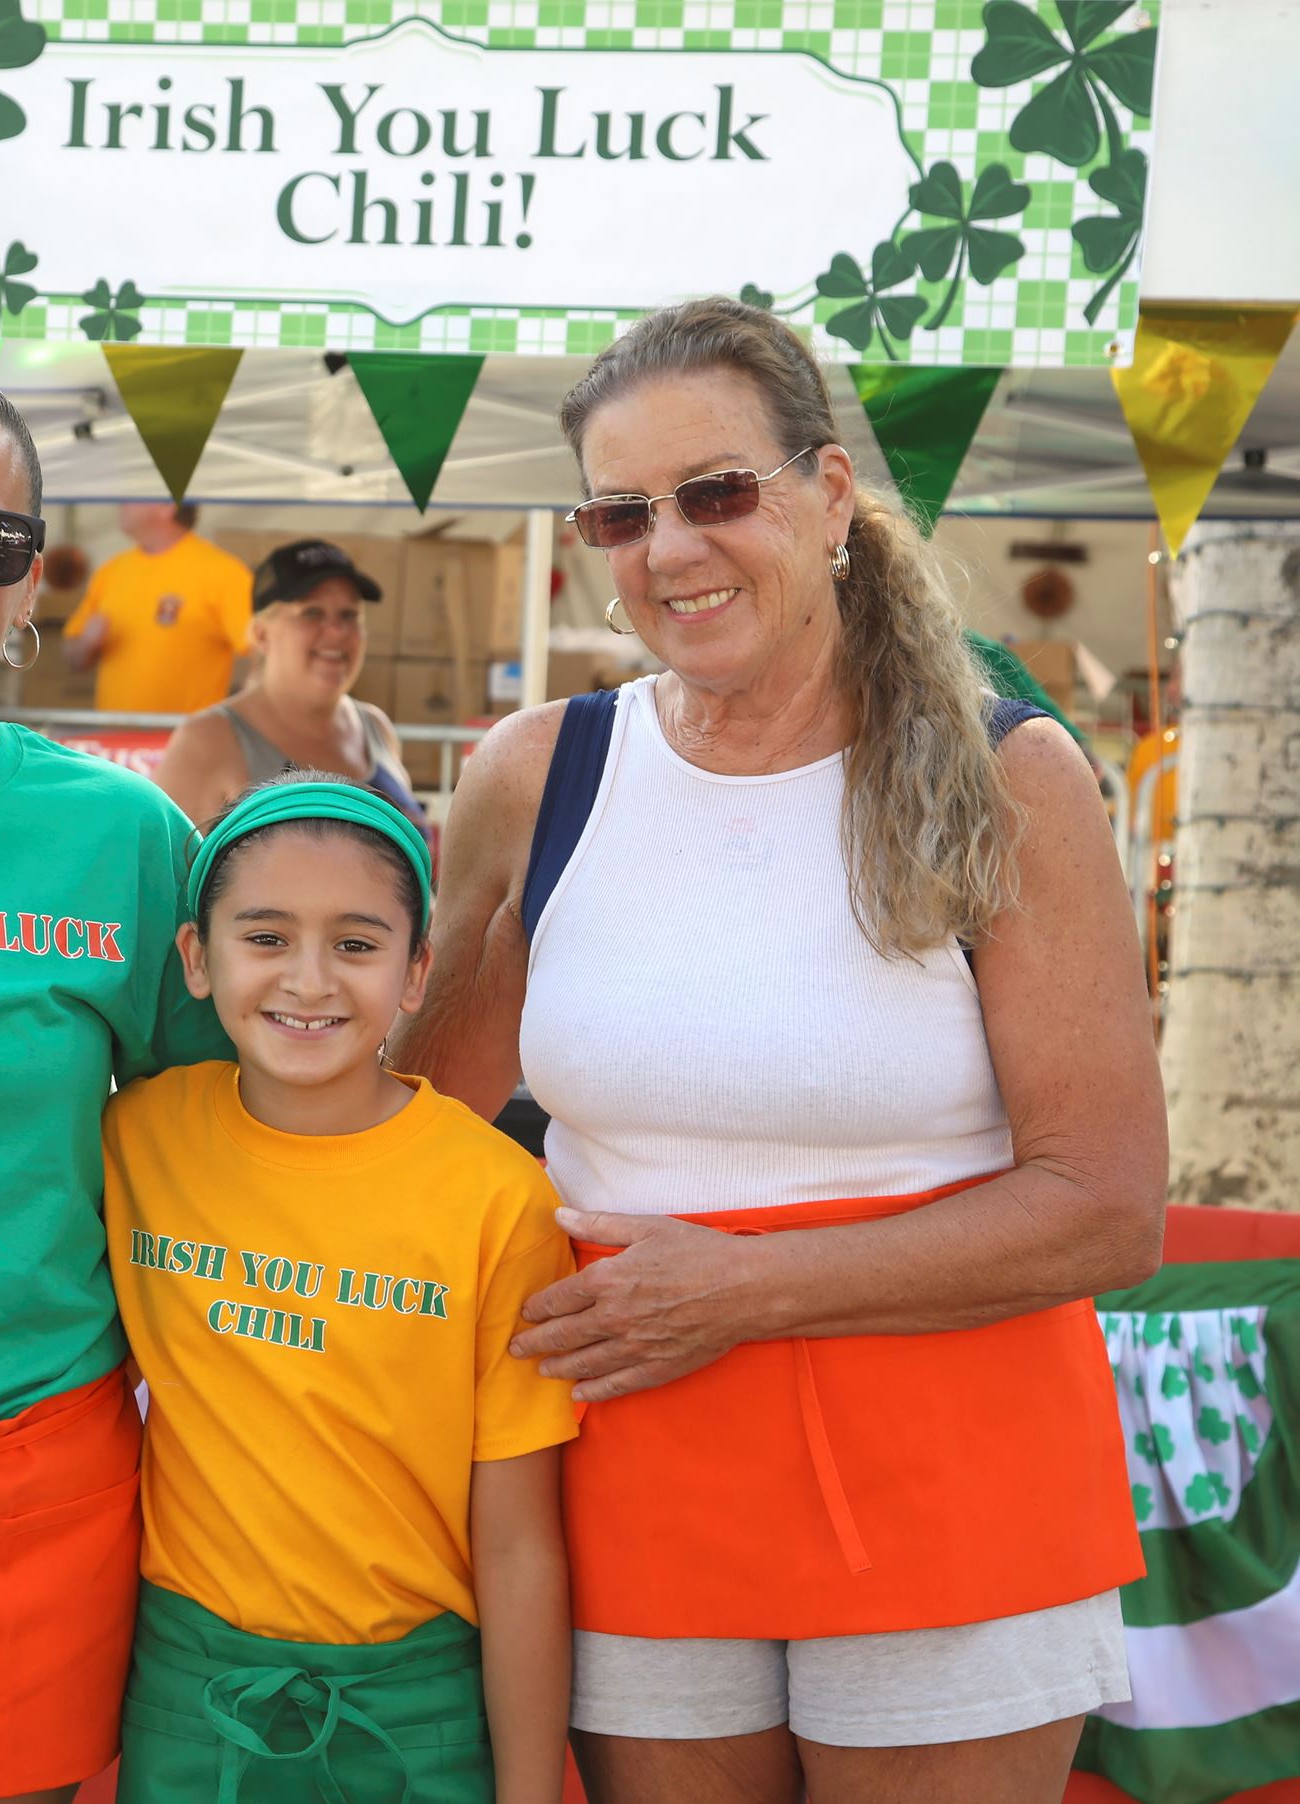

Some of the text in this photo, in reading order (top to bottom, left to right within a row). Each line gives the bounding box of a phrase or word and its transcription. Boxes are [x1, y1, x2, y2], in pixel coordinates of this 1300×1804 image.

[63, 76, 769, 162] Irish You Luck
[275, 170, 536, 250] Chili!
[130, 1228, 451, 1320] IRISH YOU LUCK
[207, 1299, 328, 1353] CHILI
